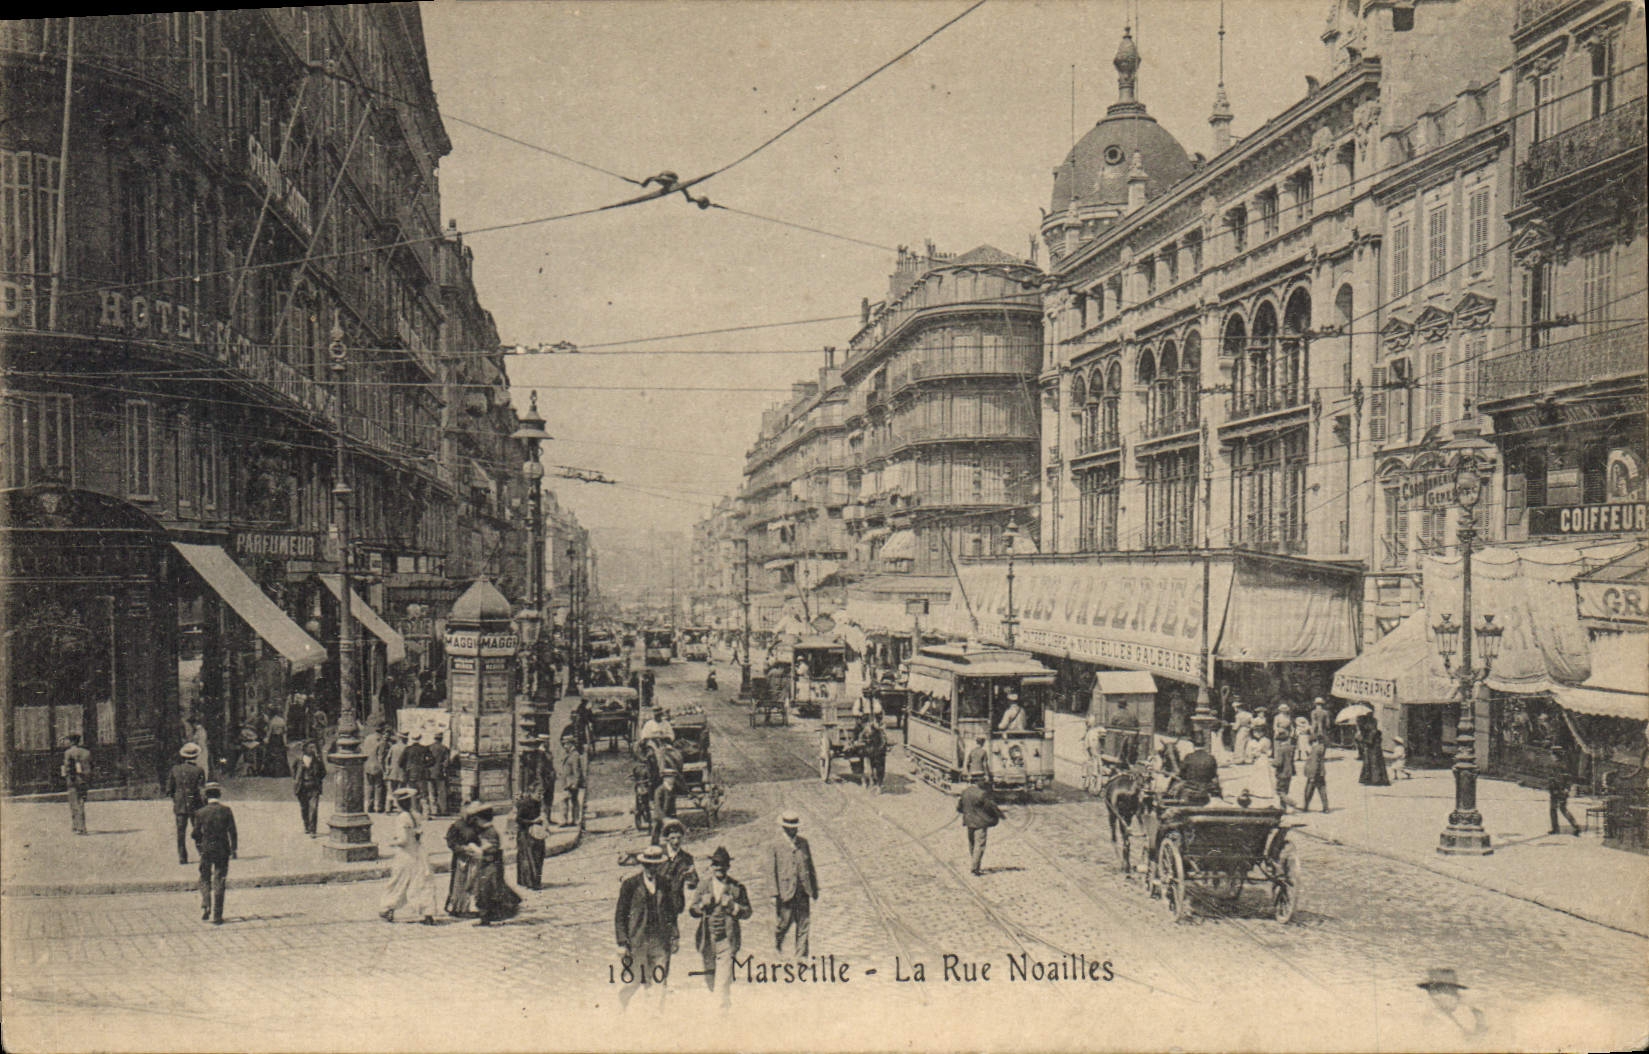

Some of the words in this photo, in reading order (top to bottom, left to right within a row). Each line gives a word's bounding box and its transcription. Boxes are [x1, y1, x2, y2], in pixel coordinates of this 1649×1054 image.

[1560, 504, 1647, 533] COIFFEUR
[236, 533, 315, 556] PARFUMEUR
[1076, 638, 1132, 661] NOUVELLES
[1136, 646, 1191, 673] GALERIES
